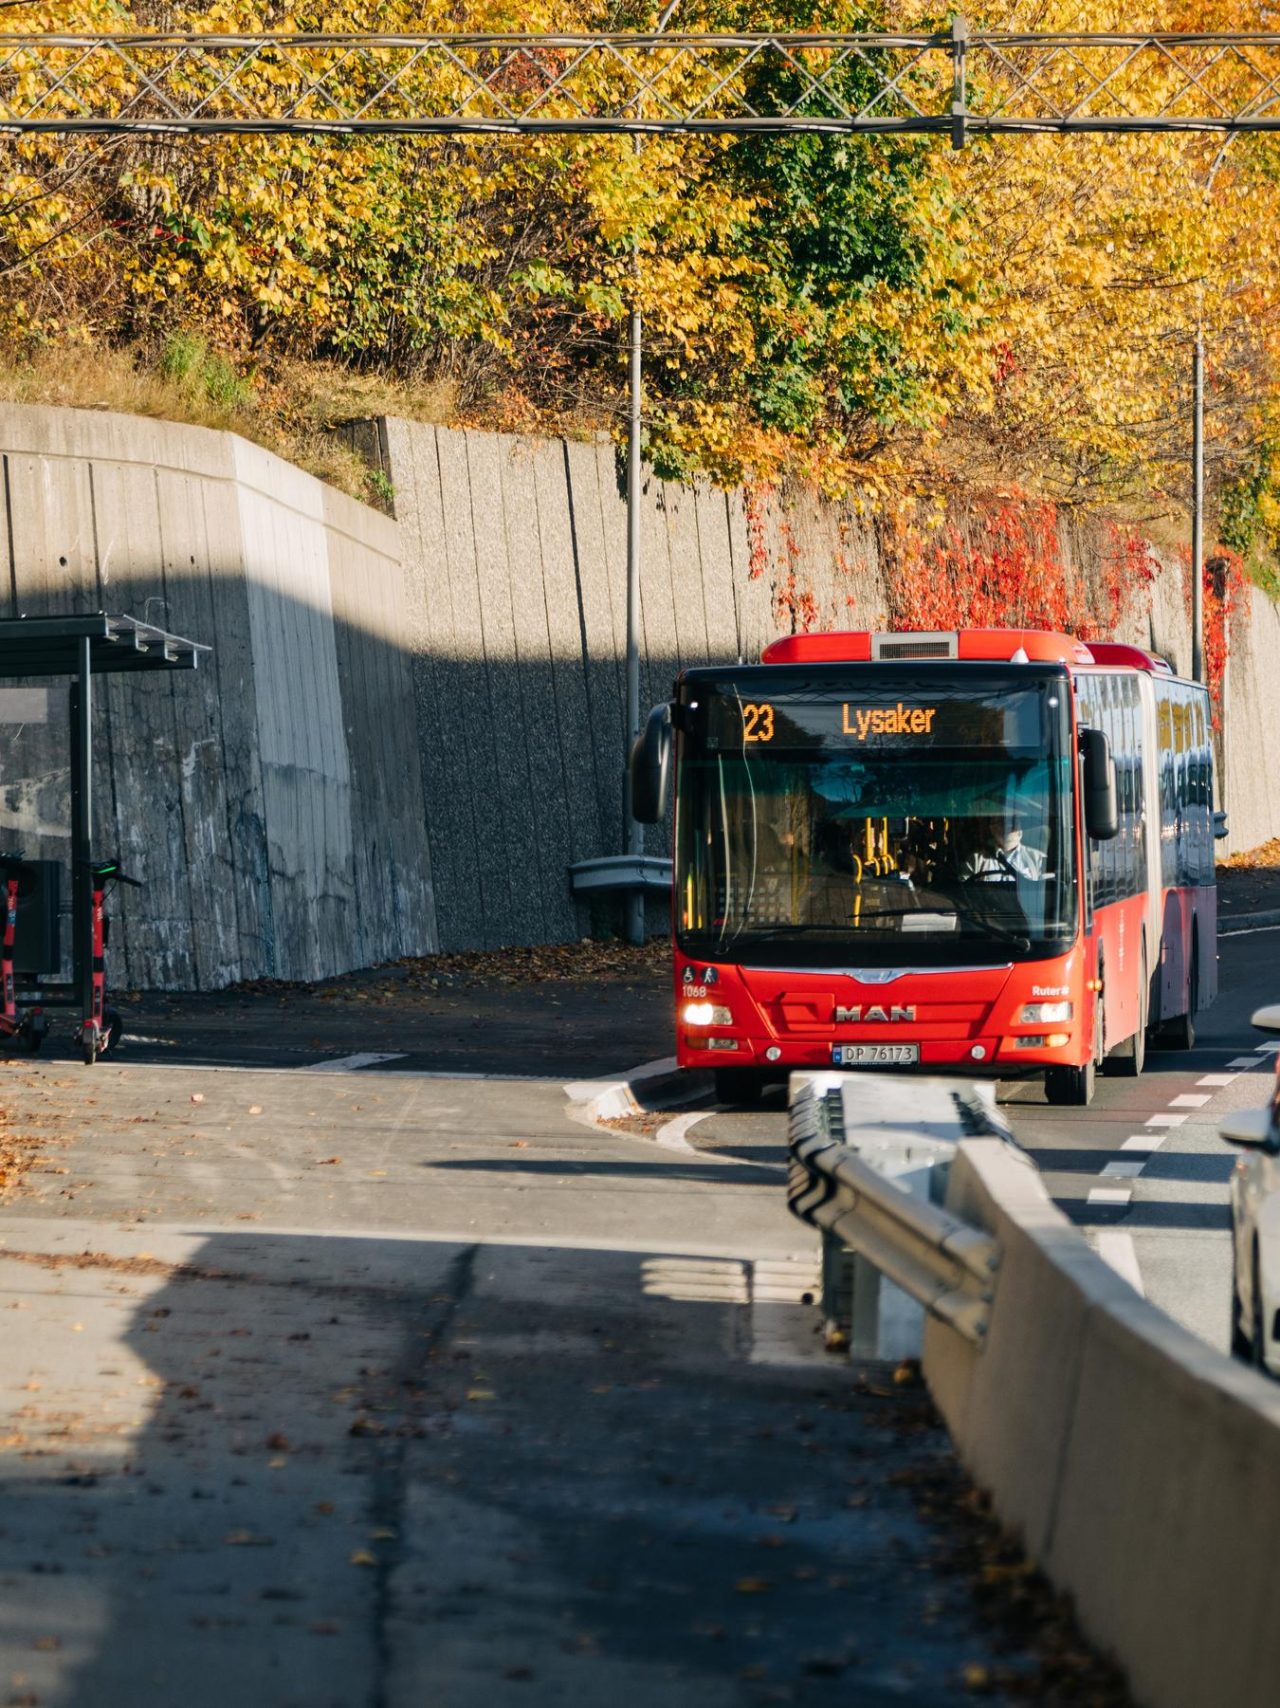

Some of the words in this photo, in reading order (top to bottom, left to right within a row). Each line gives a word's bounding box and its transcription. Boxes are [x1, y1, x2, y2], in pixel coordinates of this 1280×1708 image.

[744, 704, 775, 742] 23
[842, 703, 936, 740] Lysaker
[682, 985, 706, 998] 1068
[836, 1004, 917, 1022] MAN
[846, 1047, 865, 1060] DP
[871, 1047, 912, 1060] 76173
